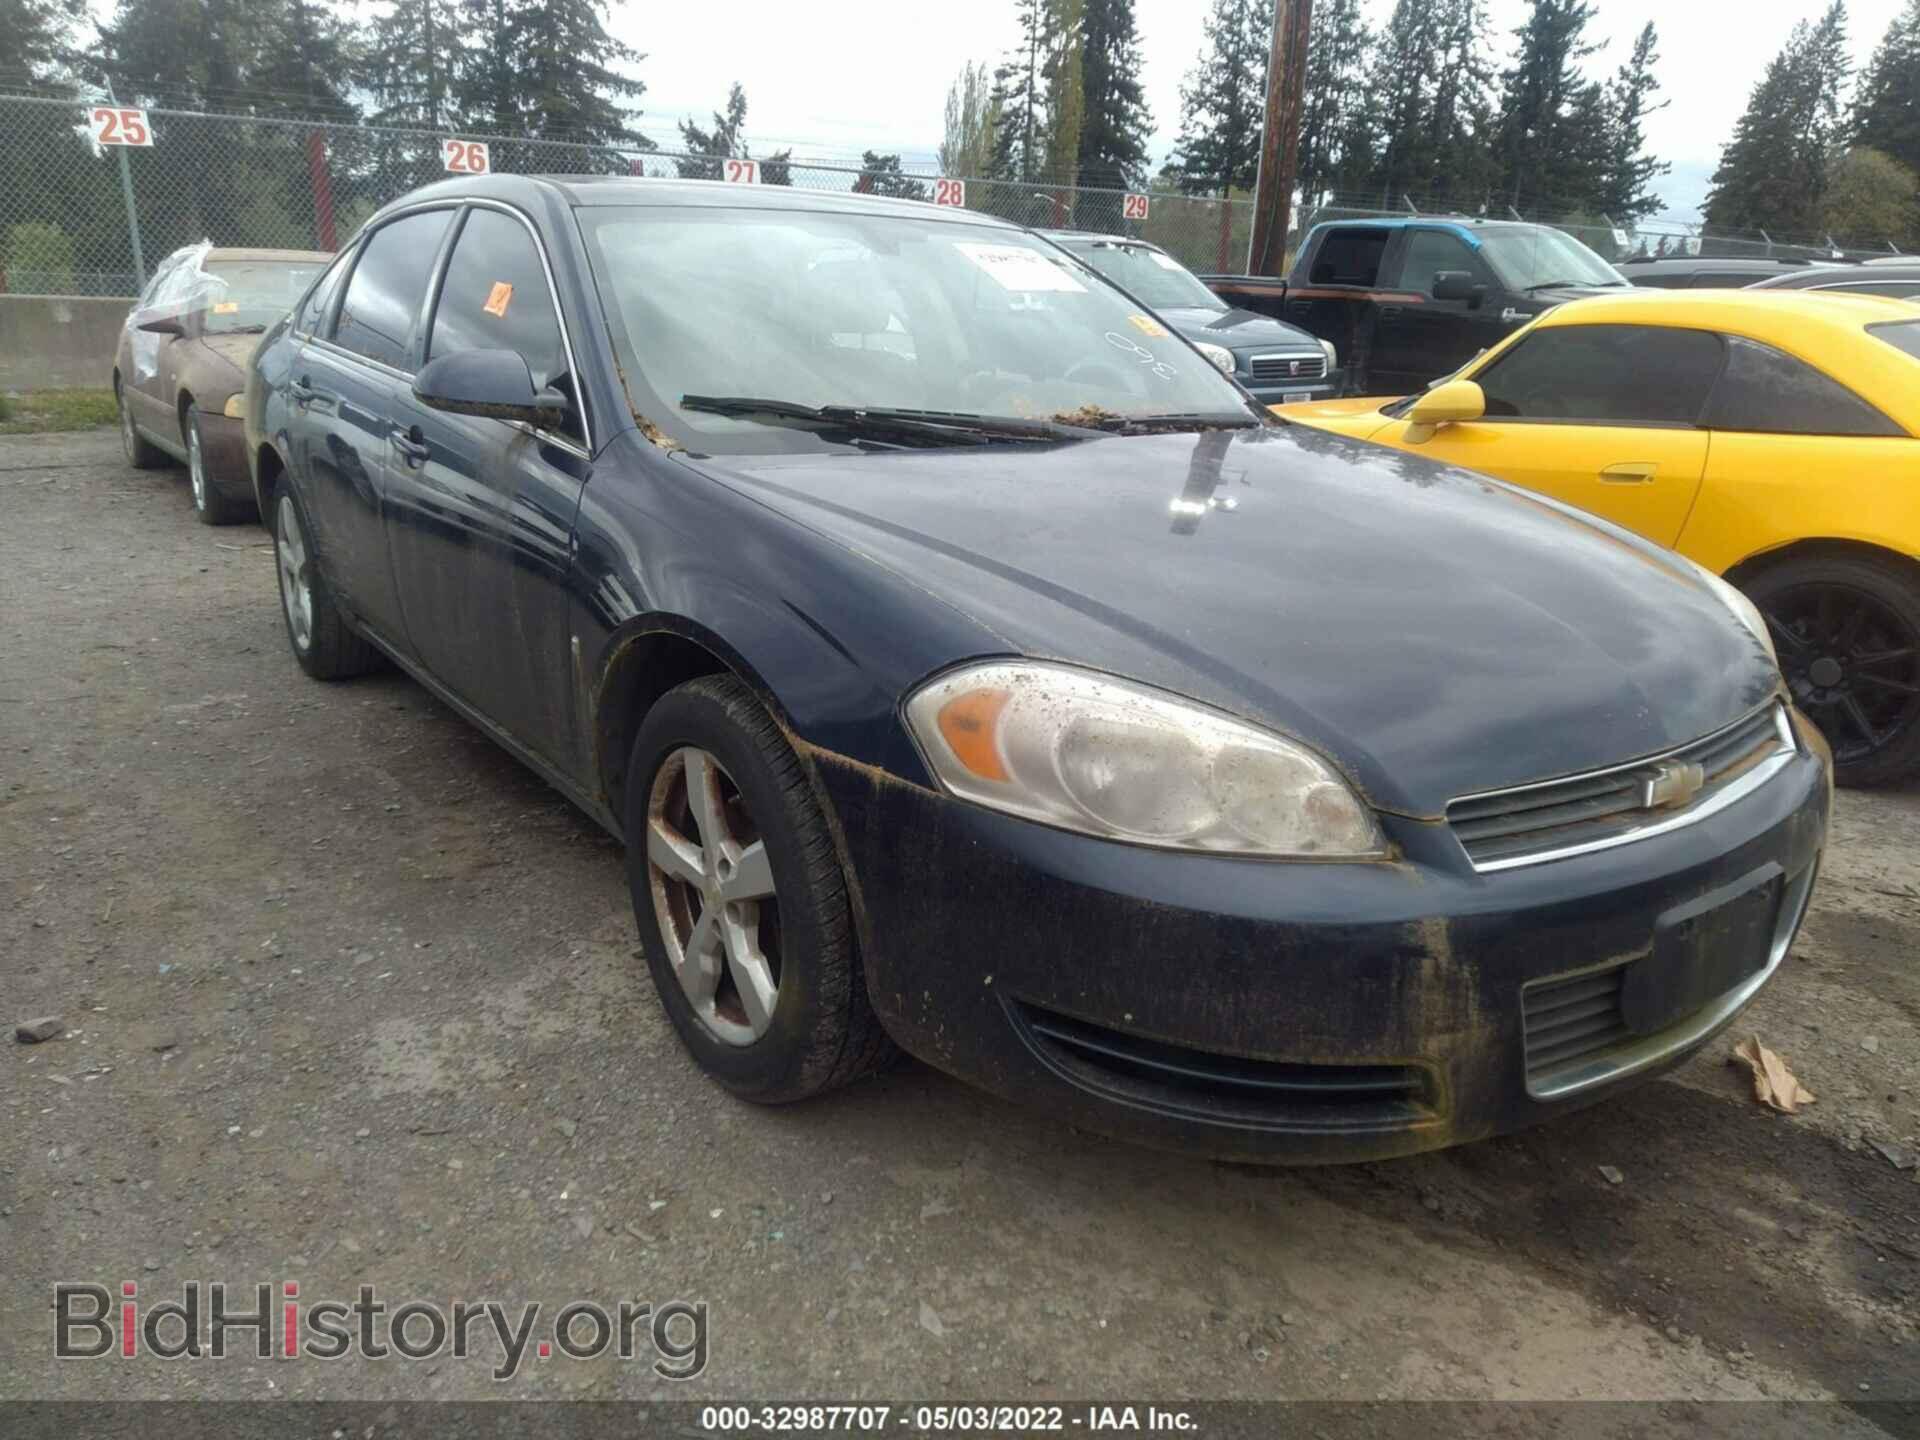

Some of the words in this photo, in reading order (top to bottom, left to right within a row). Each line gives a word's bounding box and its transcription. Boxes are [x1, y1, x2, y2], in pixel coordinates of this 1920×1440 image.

[95, 110, 145, 144] 25
[447, 142, 485, 172] 26
[728, 161, 754, 183] 27
[938, 181, 961, 205] 28
[1126, 195, 1147, 217] 29
